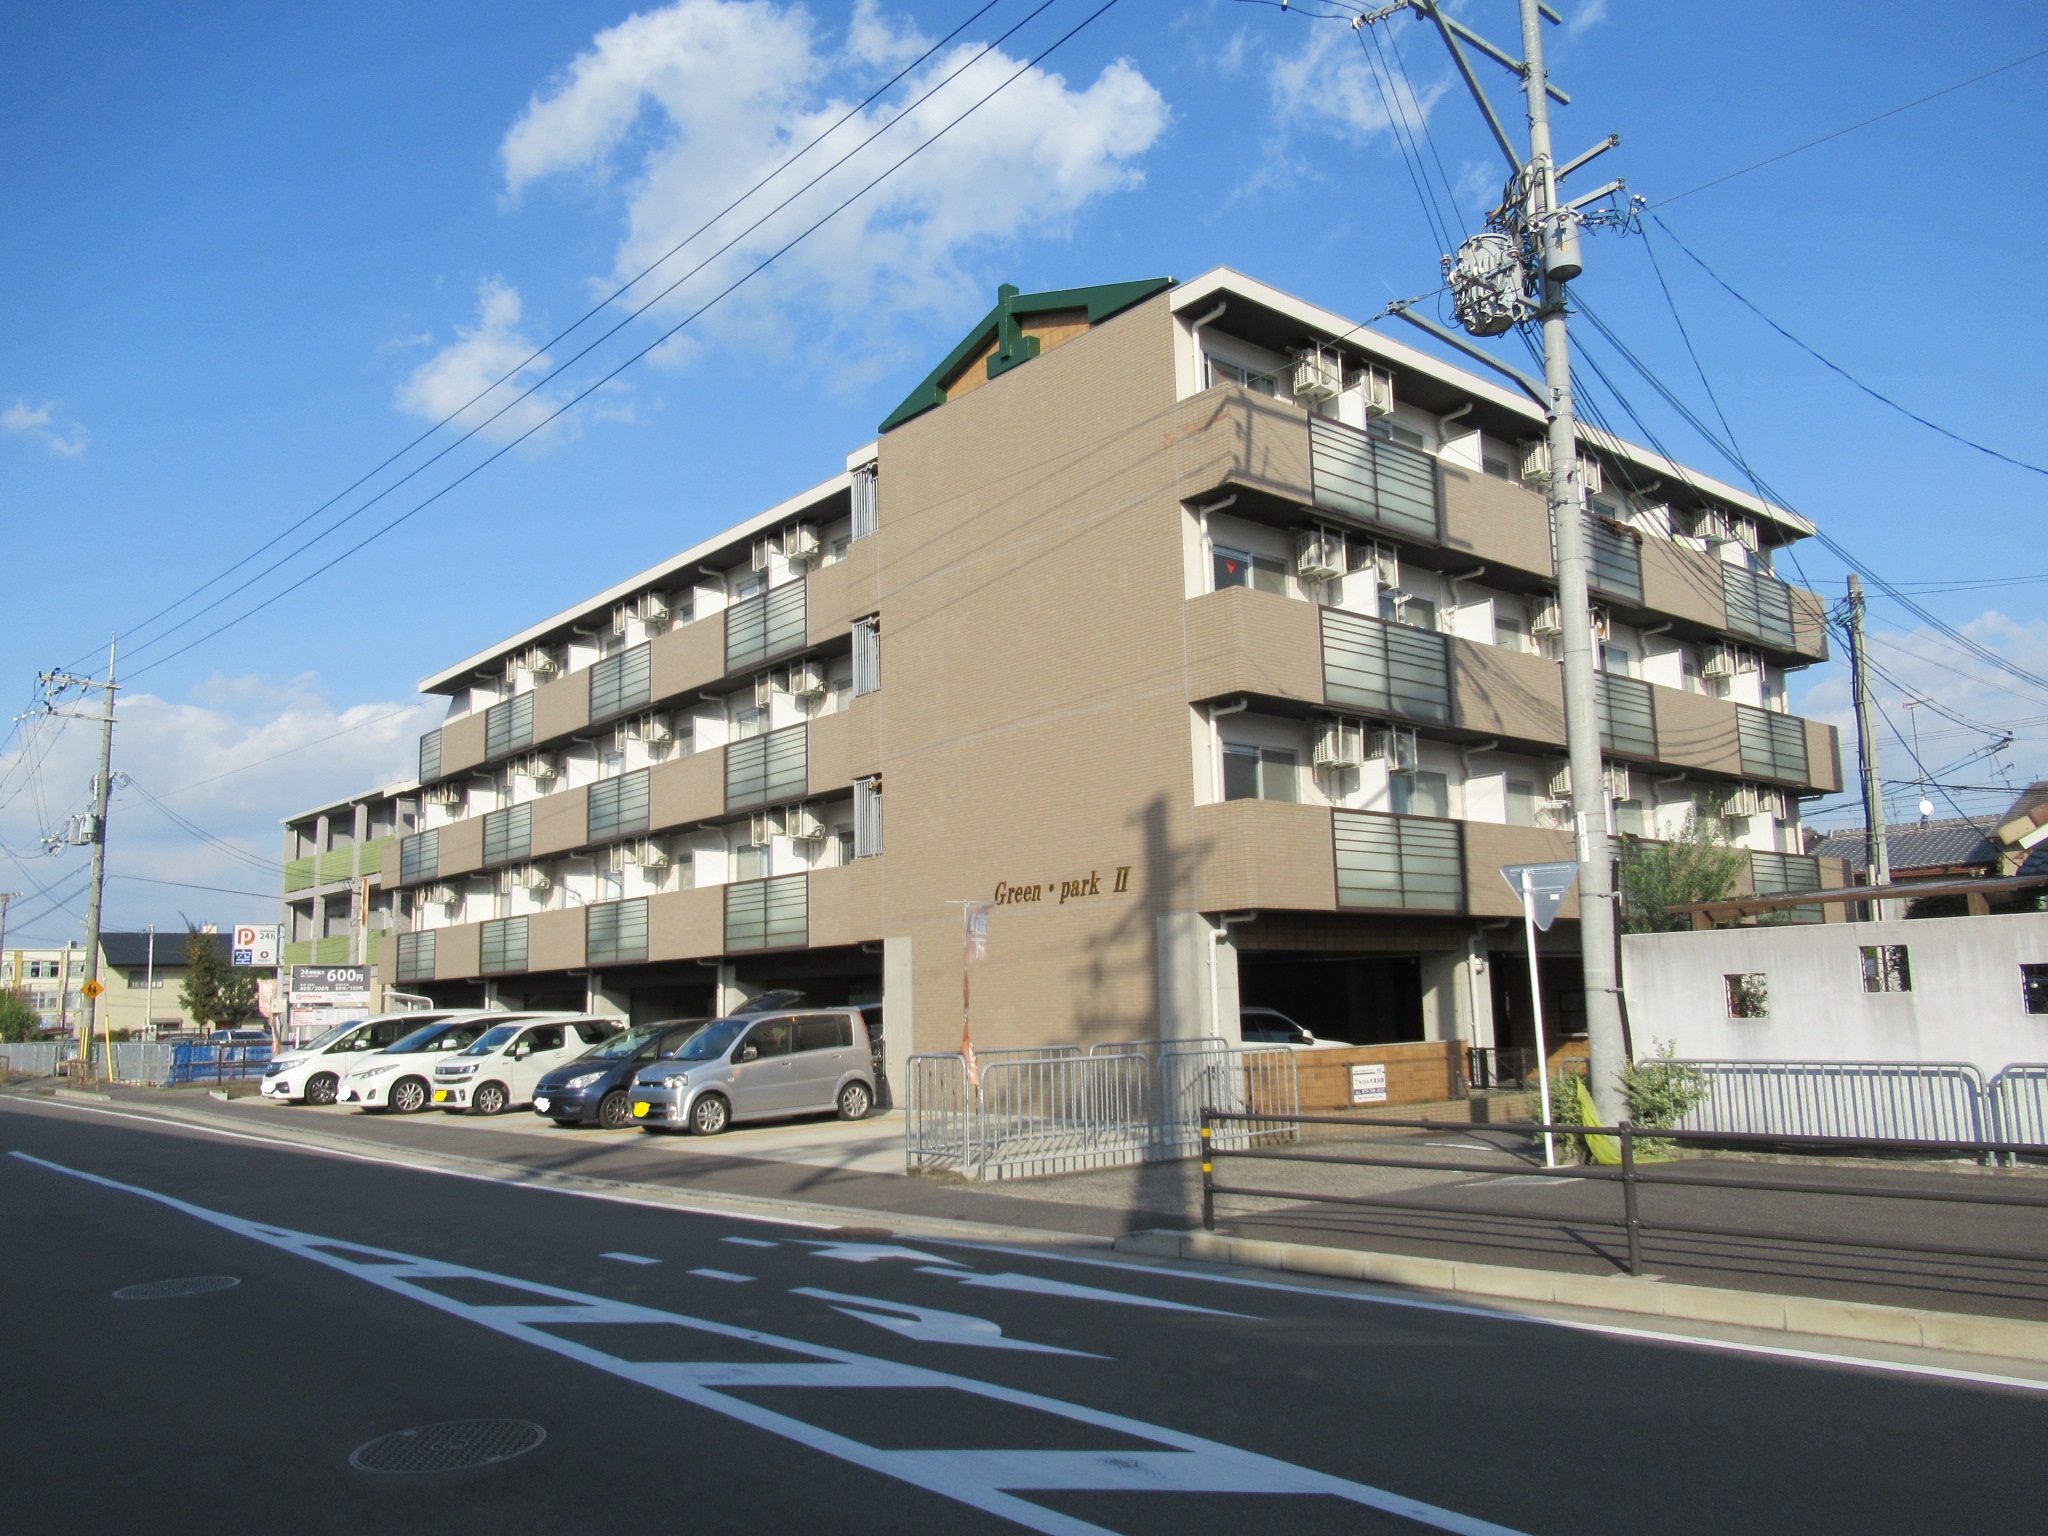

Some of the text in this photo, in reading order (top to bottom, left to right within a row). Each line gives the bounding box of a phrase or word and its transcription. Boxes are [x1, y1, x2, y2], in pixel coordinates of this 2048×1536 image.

[995, 881, 1041, 905] Green
[1059, 871, 1101, 904] park
[235, 949, 251, 965] 空
[327, 969, 364, 982] 600円
